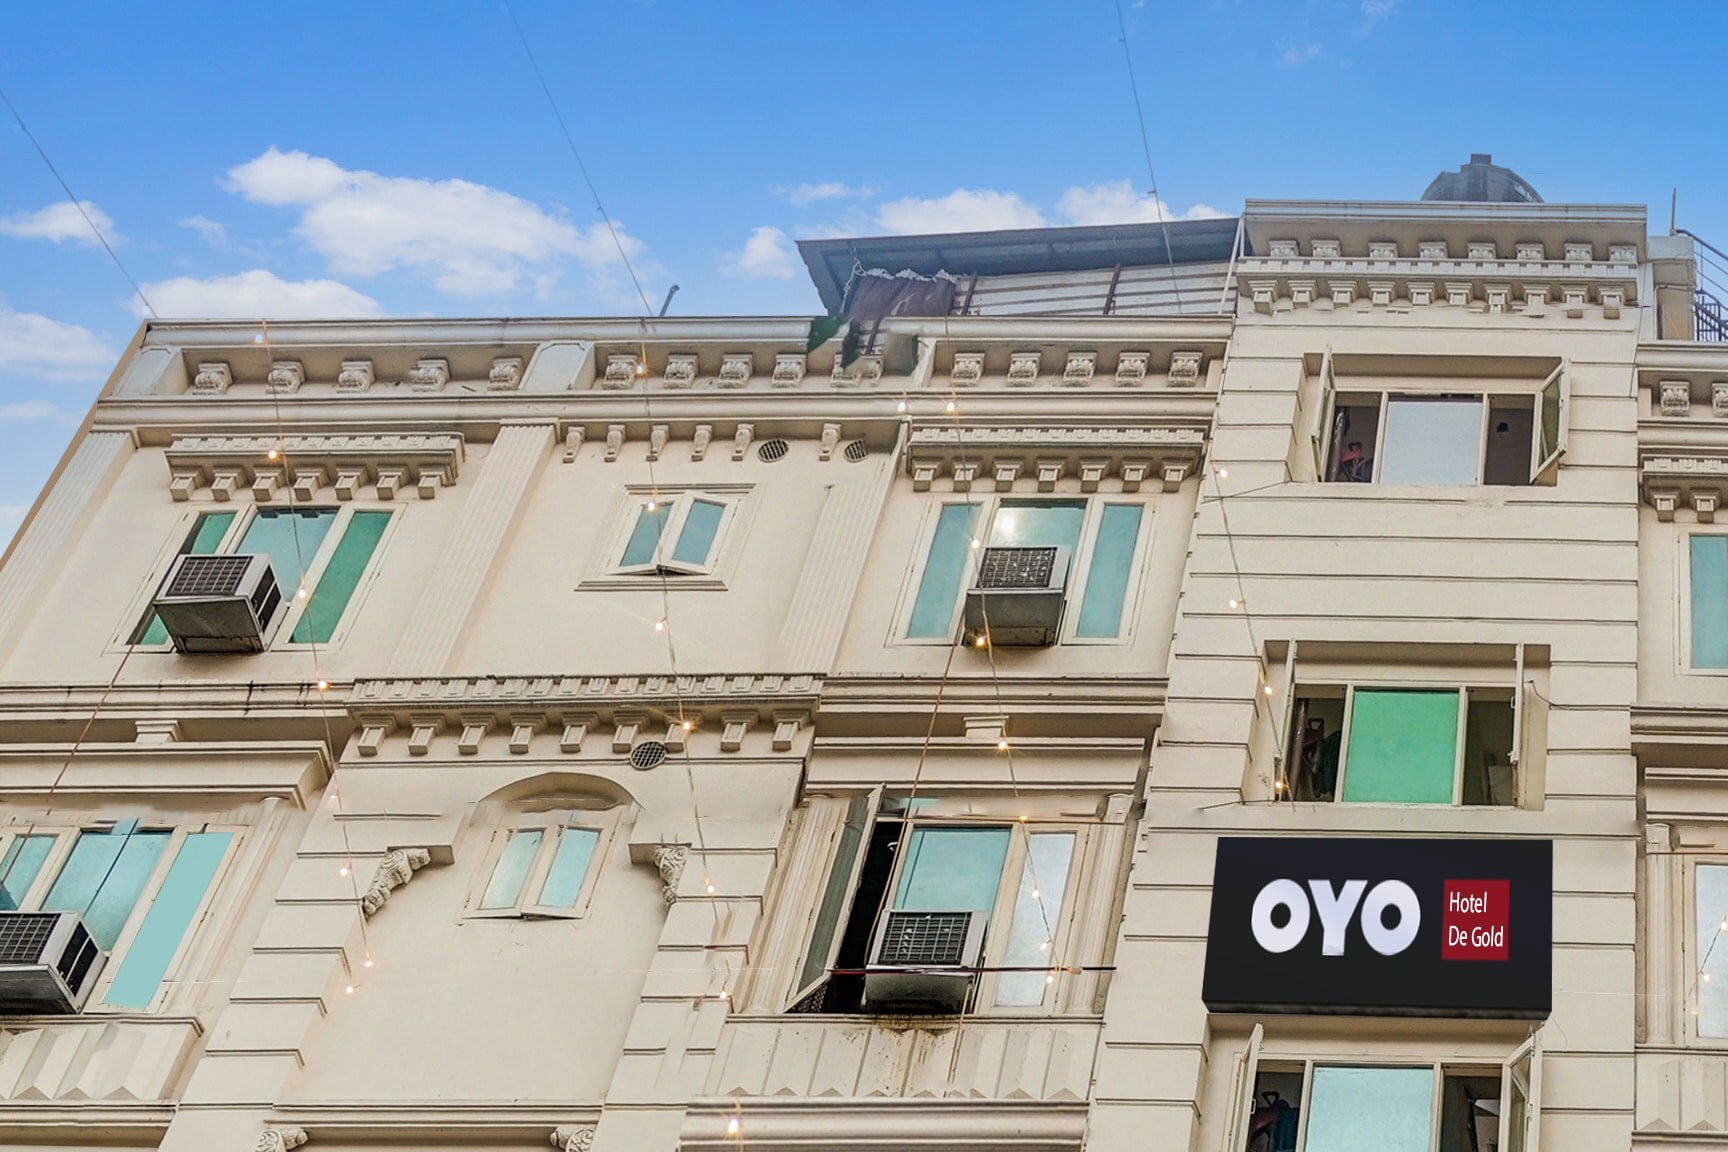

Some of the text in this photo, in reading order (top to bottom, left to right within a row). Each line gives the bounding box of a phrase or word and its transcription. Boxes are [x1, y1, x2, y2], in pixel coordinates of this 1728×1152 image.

[1448, 891, 1488, 913] Hotel
[1251, 878, 1422, 957] OYO
[1448, 925, 1504, 949] De Gold
